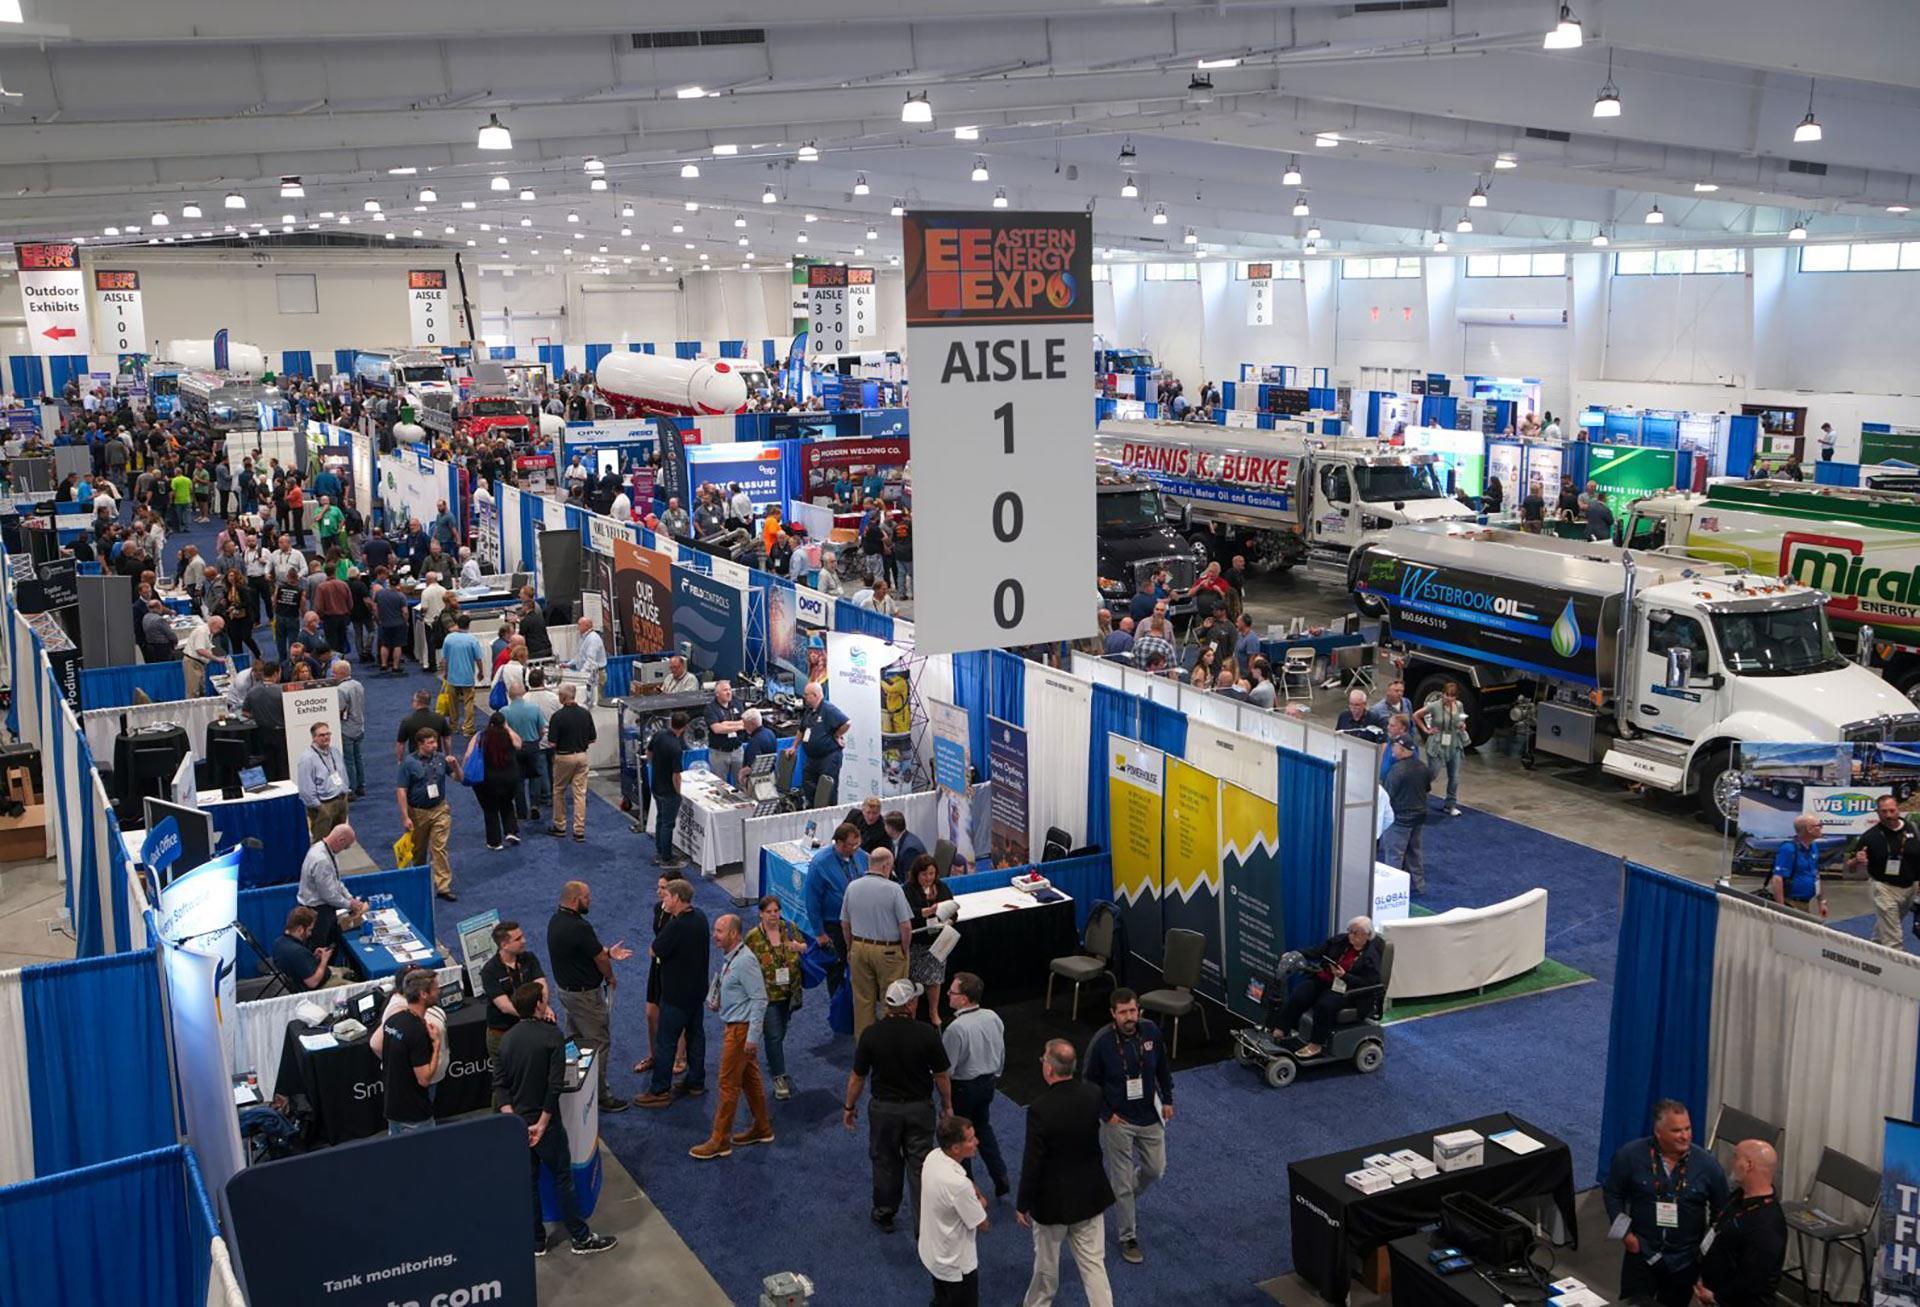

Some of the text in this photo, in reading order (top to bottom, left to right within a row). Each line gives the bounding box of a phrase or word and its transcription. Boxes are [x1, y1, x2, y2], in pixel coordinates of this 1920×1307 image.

[25, 286, 80, 296] Outdoor
[104, 293, 134, 302] AISLE
[416, 291, 441, 300] AISLE
[815, 290, 843, 300] AISLE
[30, 302, 80, 312] Exhibits
[941, 338, 1067, 383] AISLE
[850, 447, 887, 455] WELDING
[1122, 443, 1289, 486] DENNIS K. BURKE
[738, 480, 777, 489] ASSURE
[1218, 490, 1229, 501] Oil
[1231, 494, 1246, 503] and
[1247, 494, 1281, 508] Gasoline
[636, 581, 654, 603] OUR
[633, 597, 661, 626] HOUSE
[1861, 601, 1917, 618] ENERGY
[64, 659, 77, 705] Podium
[294, 697, 327, 708] Outdoor
[297, 706, 326, 715] Exhibits
[1813, 799, 1843, 812] WB
[160, 833, 178, 853] Office
[1375, 891, 1409, 905] GLOBAL
[323, 1253, 457, 1293] Tank monitoring.
